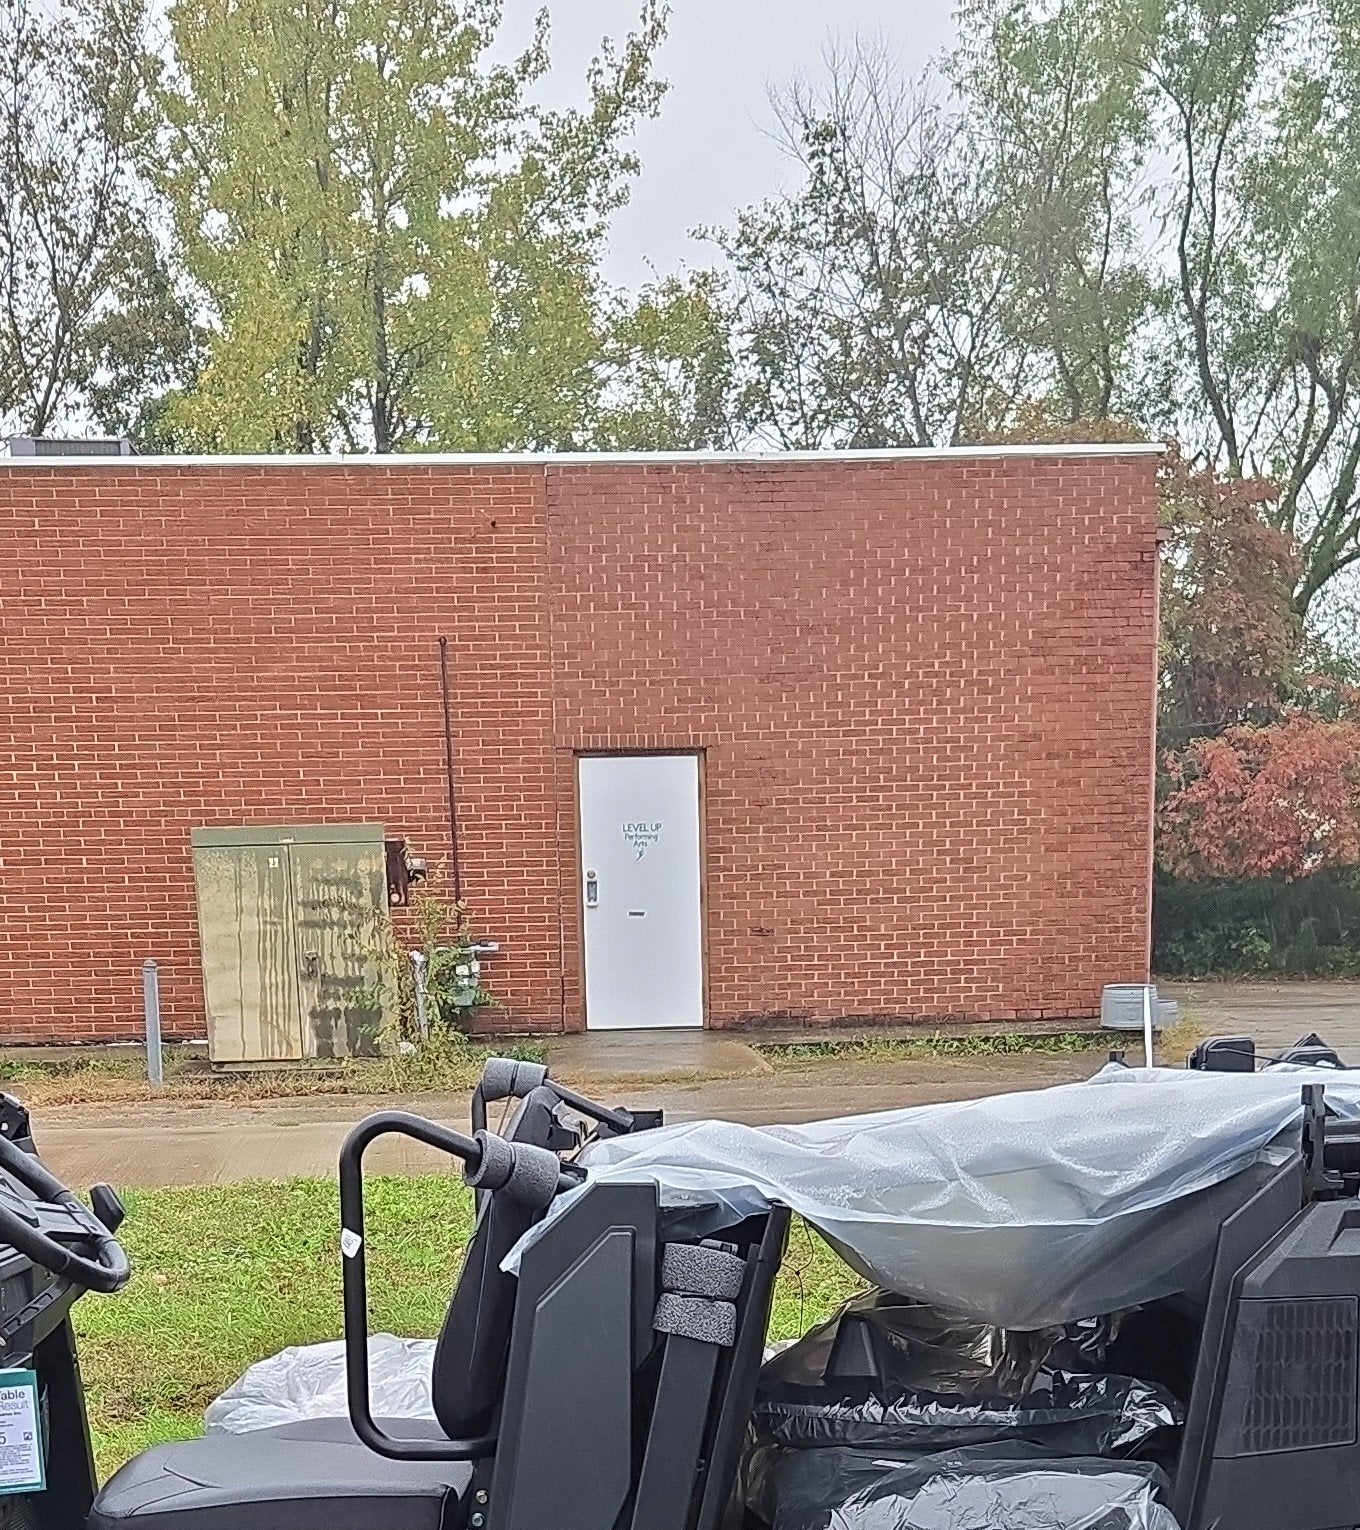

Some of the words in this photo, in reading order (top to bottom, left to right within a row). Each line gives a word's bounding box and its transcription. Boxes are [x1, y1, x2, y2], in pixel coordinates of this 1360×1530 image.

[623, 823, 649, 832] LEVEL
[651, 823, 662, 832] UP
[625, 833, 658, 842] Performing
